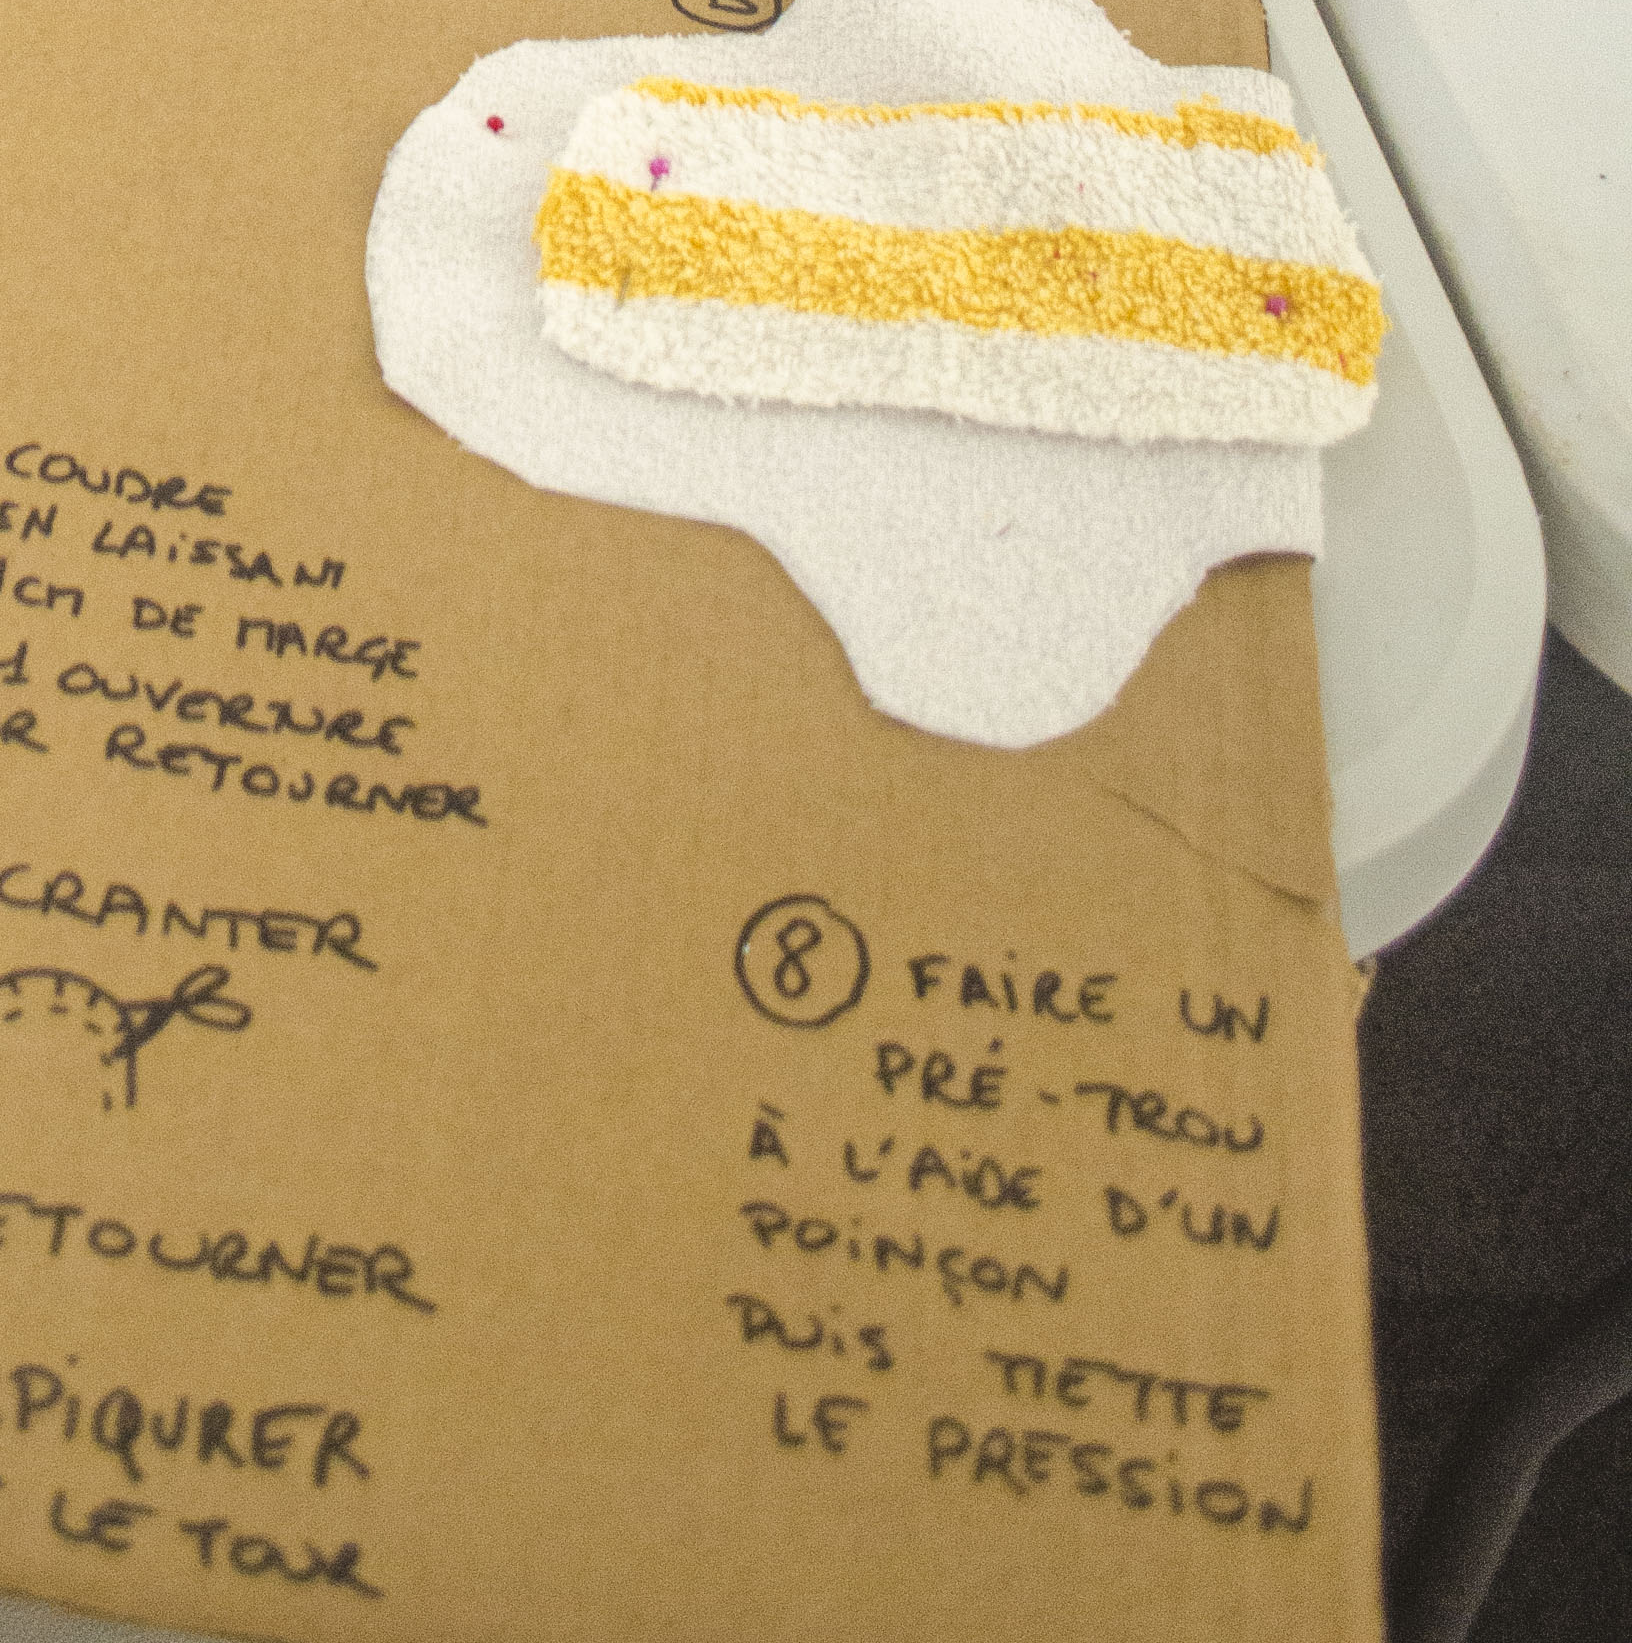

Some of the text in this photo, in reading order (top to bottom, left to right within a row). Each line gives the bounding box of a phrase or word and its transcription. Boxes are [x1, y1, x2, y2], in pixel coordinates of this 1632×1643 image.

[5, 443, 232, 516] COUDRE
[132, 597, 203, 638] DE
[236, 617, 420, 682] MARGE
[57, 663, 415, 756] OUVERTURE
[106, 724, 487, 827] RETOURNER
[1180, 990, 1270, 1043] UN
[1104, 1186, 1279, 1252] D'UN
[772, 1393, 868, 1456] LE
[50, 1491, 154, 1554] LE
[179, 1519, 384, 1600] TOUR
